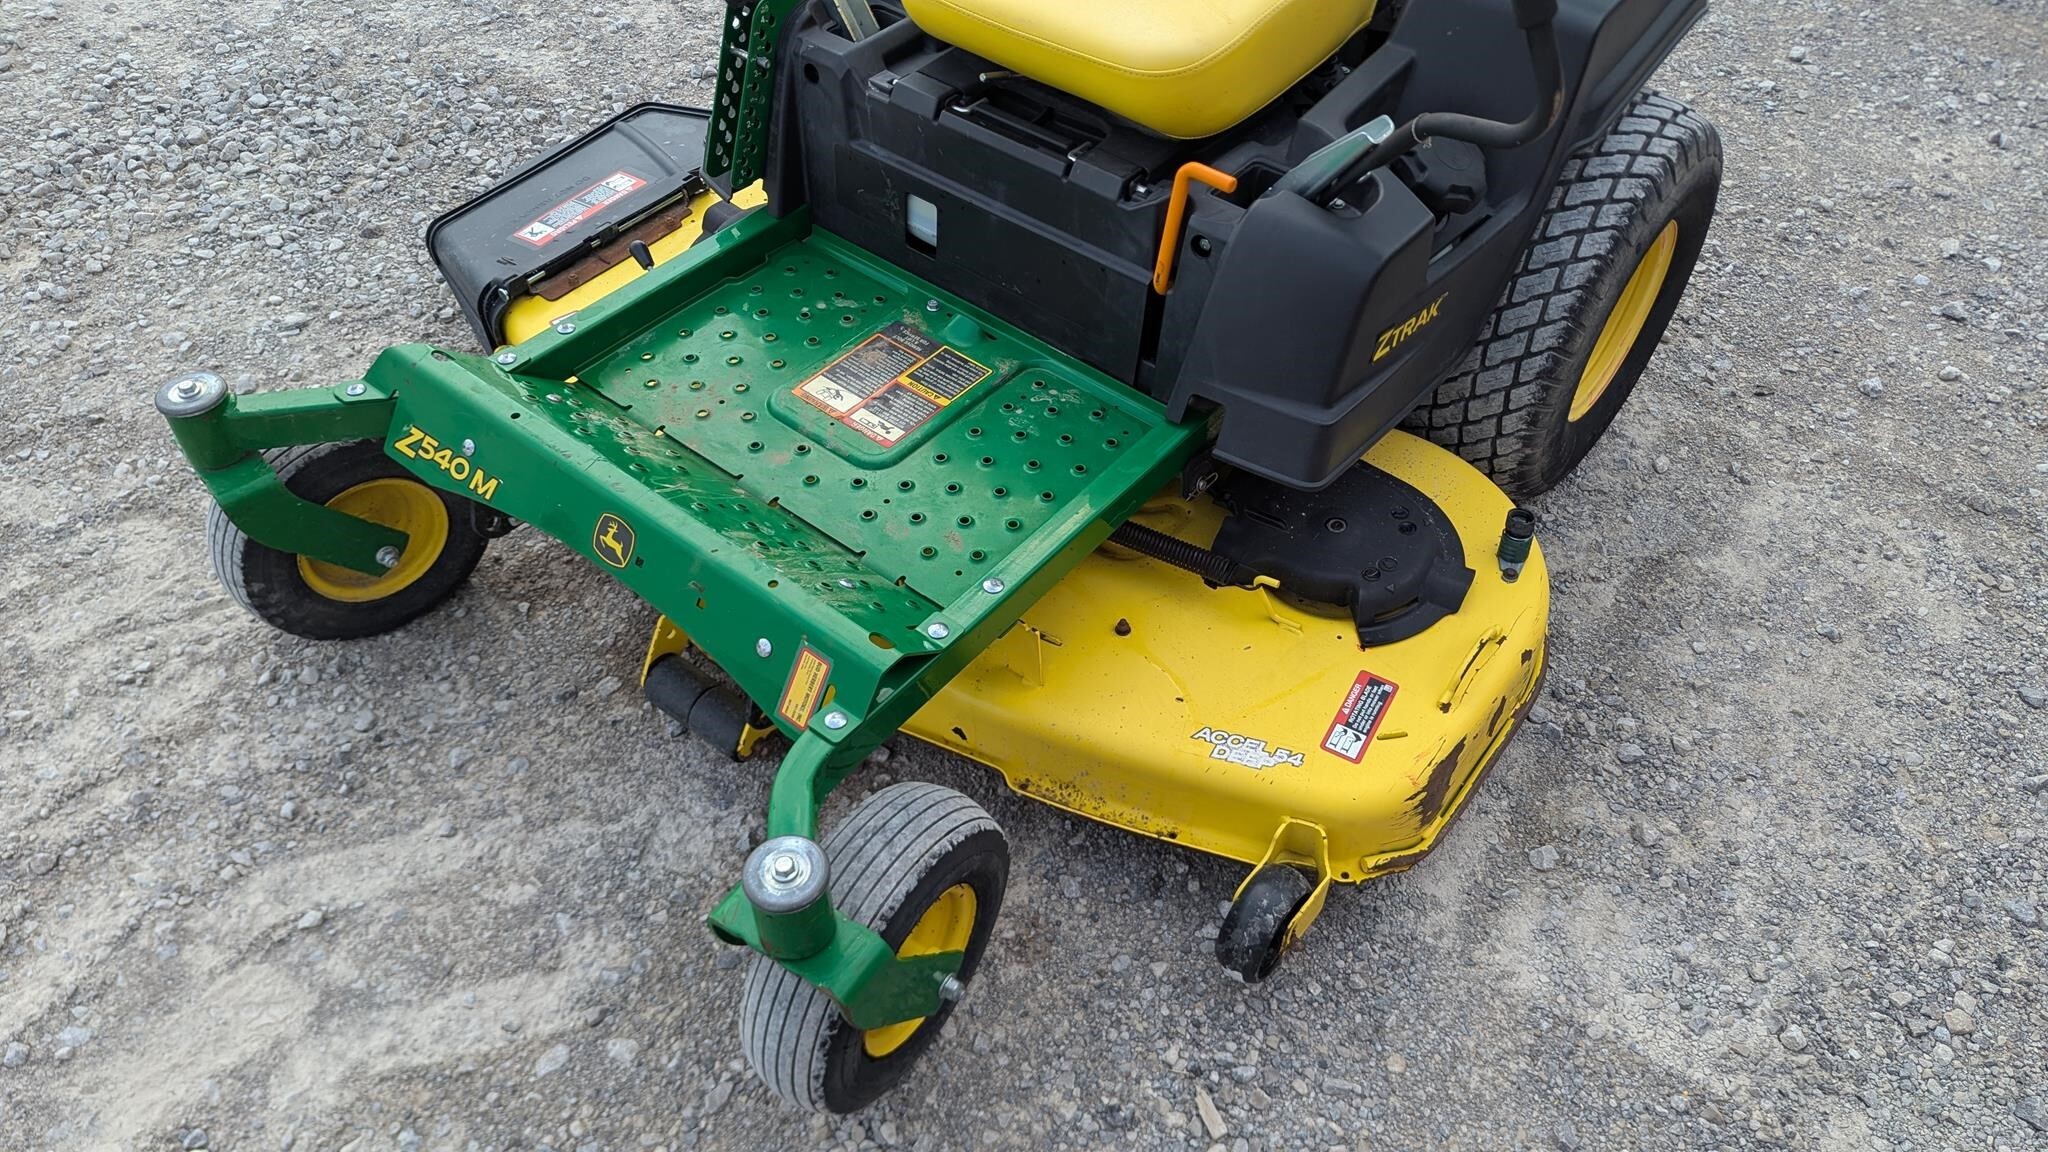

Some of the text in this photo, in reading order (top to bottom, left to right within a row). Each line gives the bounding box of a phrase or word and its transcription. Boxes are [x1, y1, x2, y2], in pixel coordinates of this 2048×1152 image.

[1372, 294, 1444, 362] ZTRAK
[907, 381, 934, 397] CAUTION
[850, 421, 878, 438] DANGER
[394, 426, 499, 501] Z540 M
[1345, 683, 1362, 708] DANGER
[1349, 684, 1372, 723] ROTATING BLADE
[1192, 727, 1267, 752] ACCEL
[1273, 747, 1305, 768] 54
